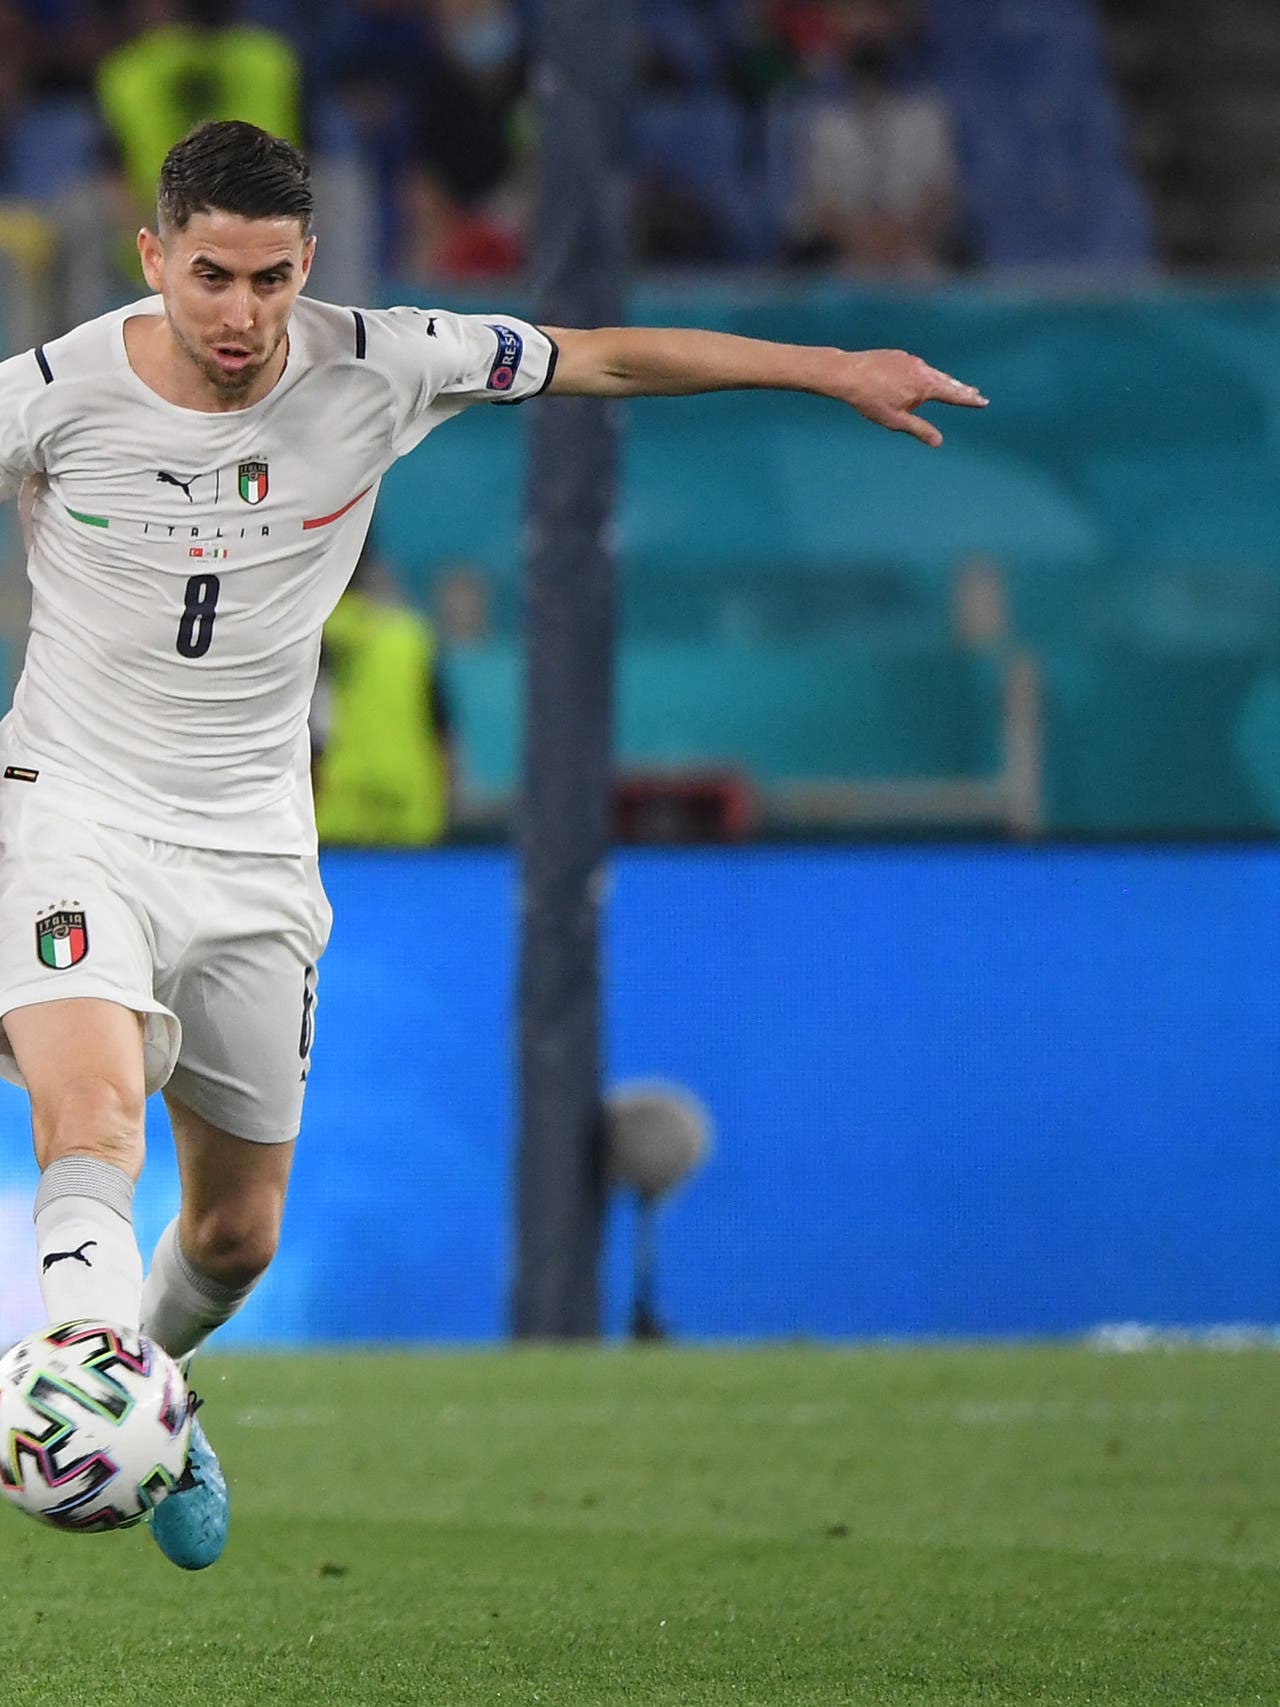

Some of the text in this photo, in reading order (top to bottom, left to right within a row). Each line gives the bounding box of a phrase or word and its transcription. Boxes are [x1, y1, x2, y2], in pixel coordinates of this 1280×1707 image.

[143, 522, 270, 538] ITALIA
[176, 573, 221, 659] 8
[38, 914, 82, 932] ITALIA
